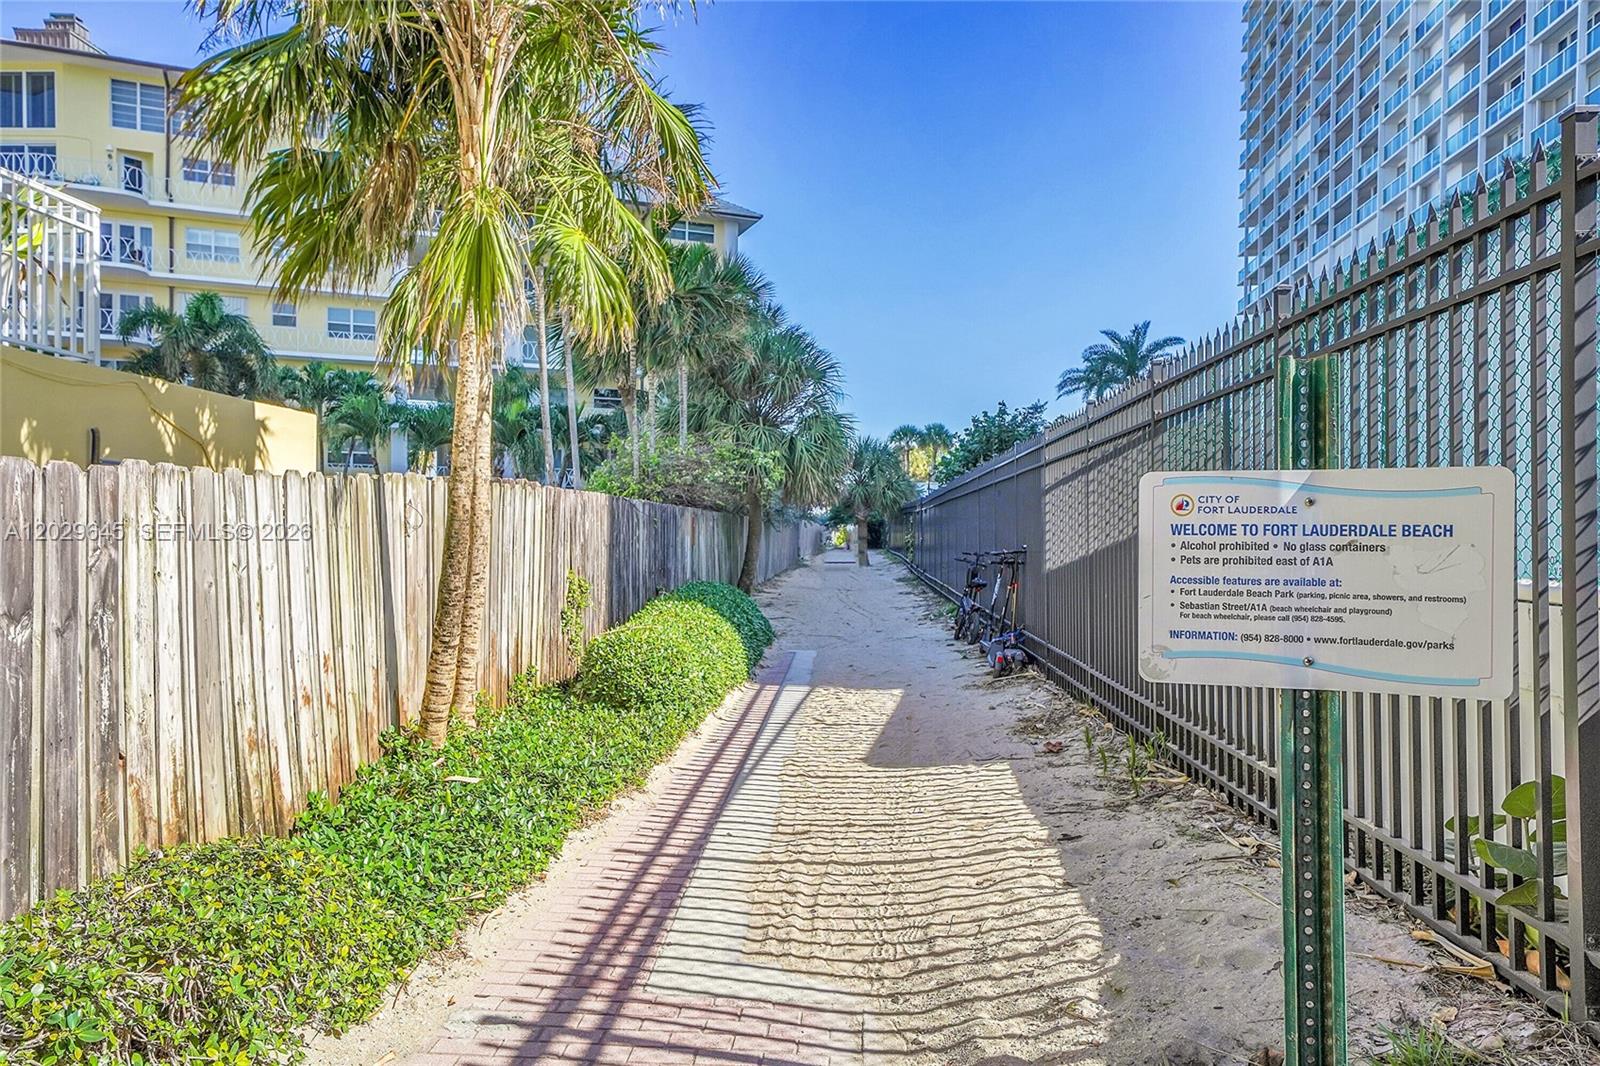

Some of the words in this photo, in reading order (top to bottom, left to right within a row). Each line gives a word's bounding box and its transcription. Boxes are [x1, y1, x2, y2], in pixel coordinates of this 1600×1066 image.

[1198, 495, 1222, 504] CITY
[1225, 495, 1240, 504] OF
[1198, 506, 1225, 514] FORT
[1228, 505, 1298, 514] LAUDERDALE
[1171, 523, 1237, 536] WELCOME
[1241, 523, 1259, 536] TO
[1263, 524, 1298, 536] FORT
[1302, 524, 1397, 537] LAUDERDALE
[1401, 524, 1454, 538] BEACH
[1180, 541, 1216, 551] Alcohol
[1219, 541, 1270, 553] prohibited
[1283, 542, 1297, 551] No
[1299, 542, 1327, 554] glass
[1329, 543, 1386, 552] containers
[1180, 555, 1201, 565] Pets
[1204, 557, 1219, 566] are
[1222, 556, 1273, 567] prohibited
[1275, 557, 1298, 566] east
[1300, 556, 1310, 566] of
[1312, 557, 1334, 566] A1A
[1170, 575, 1220, 585] Accessible
[1223, 576, 1262, 586] features
[1283, 577, 1327, 587] available
[1329, 579, 1342, 587] at:
[1180, 588, 1197, 596] Fort
[1199, 589, 1244, 598] Lauderdale
[1246, 589, 1272, 598] Beach
[1275, 590, 1294, 599] Park
[1296, 592, 1327, 600] (parking,
[1328, 592, 1350, 600] picnic
[1372, 594, 1406, 602] showers,
[1424, 595, 1467, 604] restrooms)
[1180, 602, 1220, 611] Sebastian
[1222, 603, 1267, 612] Street/A1A
[1269, 605, 1293, 613] (beach
[1294, 606, 1332, 614] wheelchair
[1349, 608, 1393, 616] playground)
[1192, 612, 1212, 620] beach
[1214, 613, 1252, 622] wheelchair,
[1254, 615, 1276, 623] please
[1291, 615, 1309, 624] (954)
[1169, 630, 1237, 641] INFORMATION:
[1240, 634, 1262, 643] (954)
[1264, 634, 1304, 644] 828-8000
[1313, 636, 1455, 650] www.fortlauderdale.gov/parks
